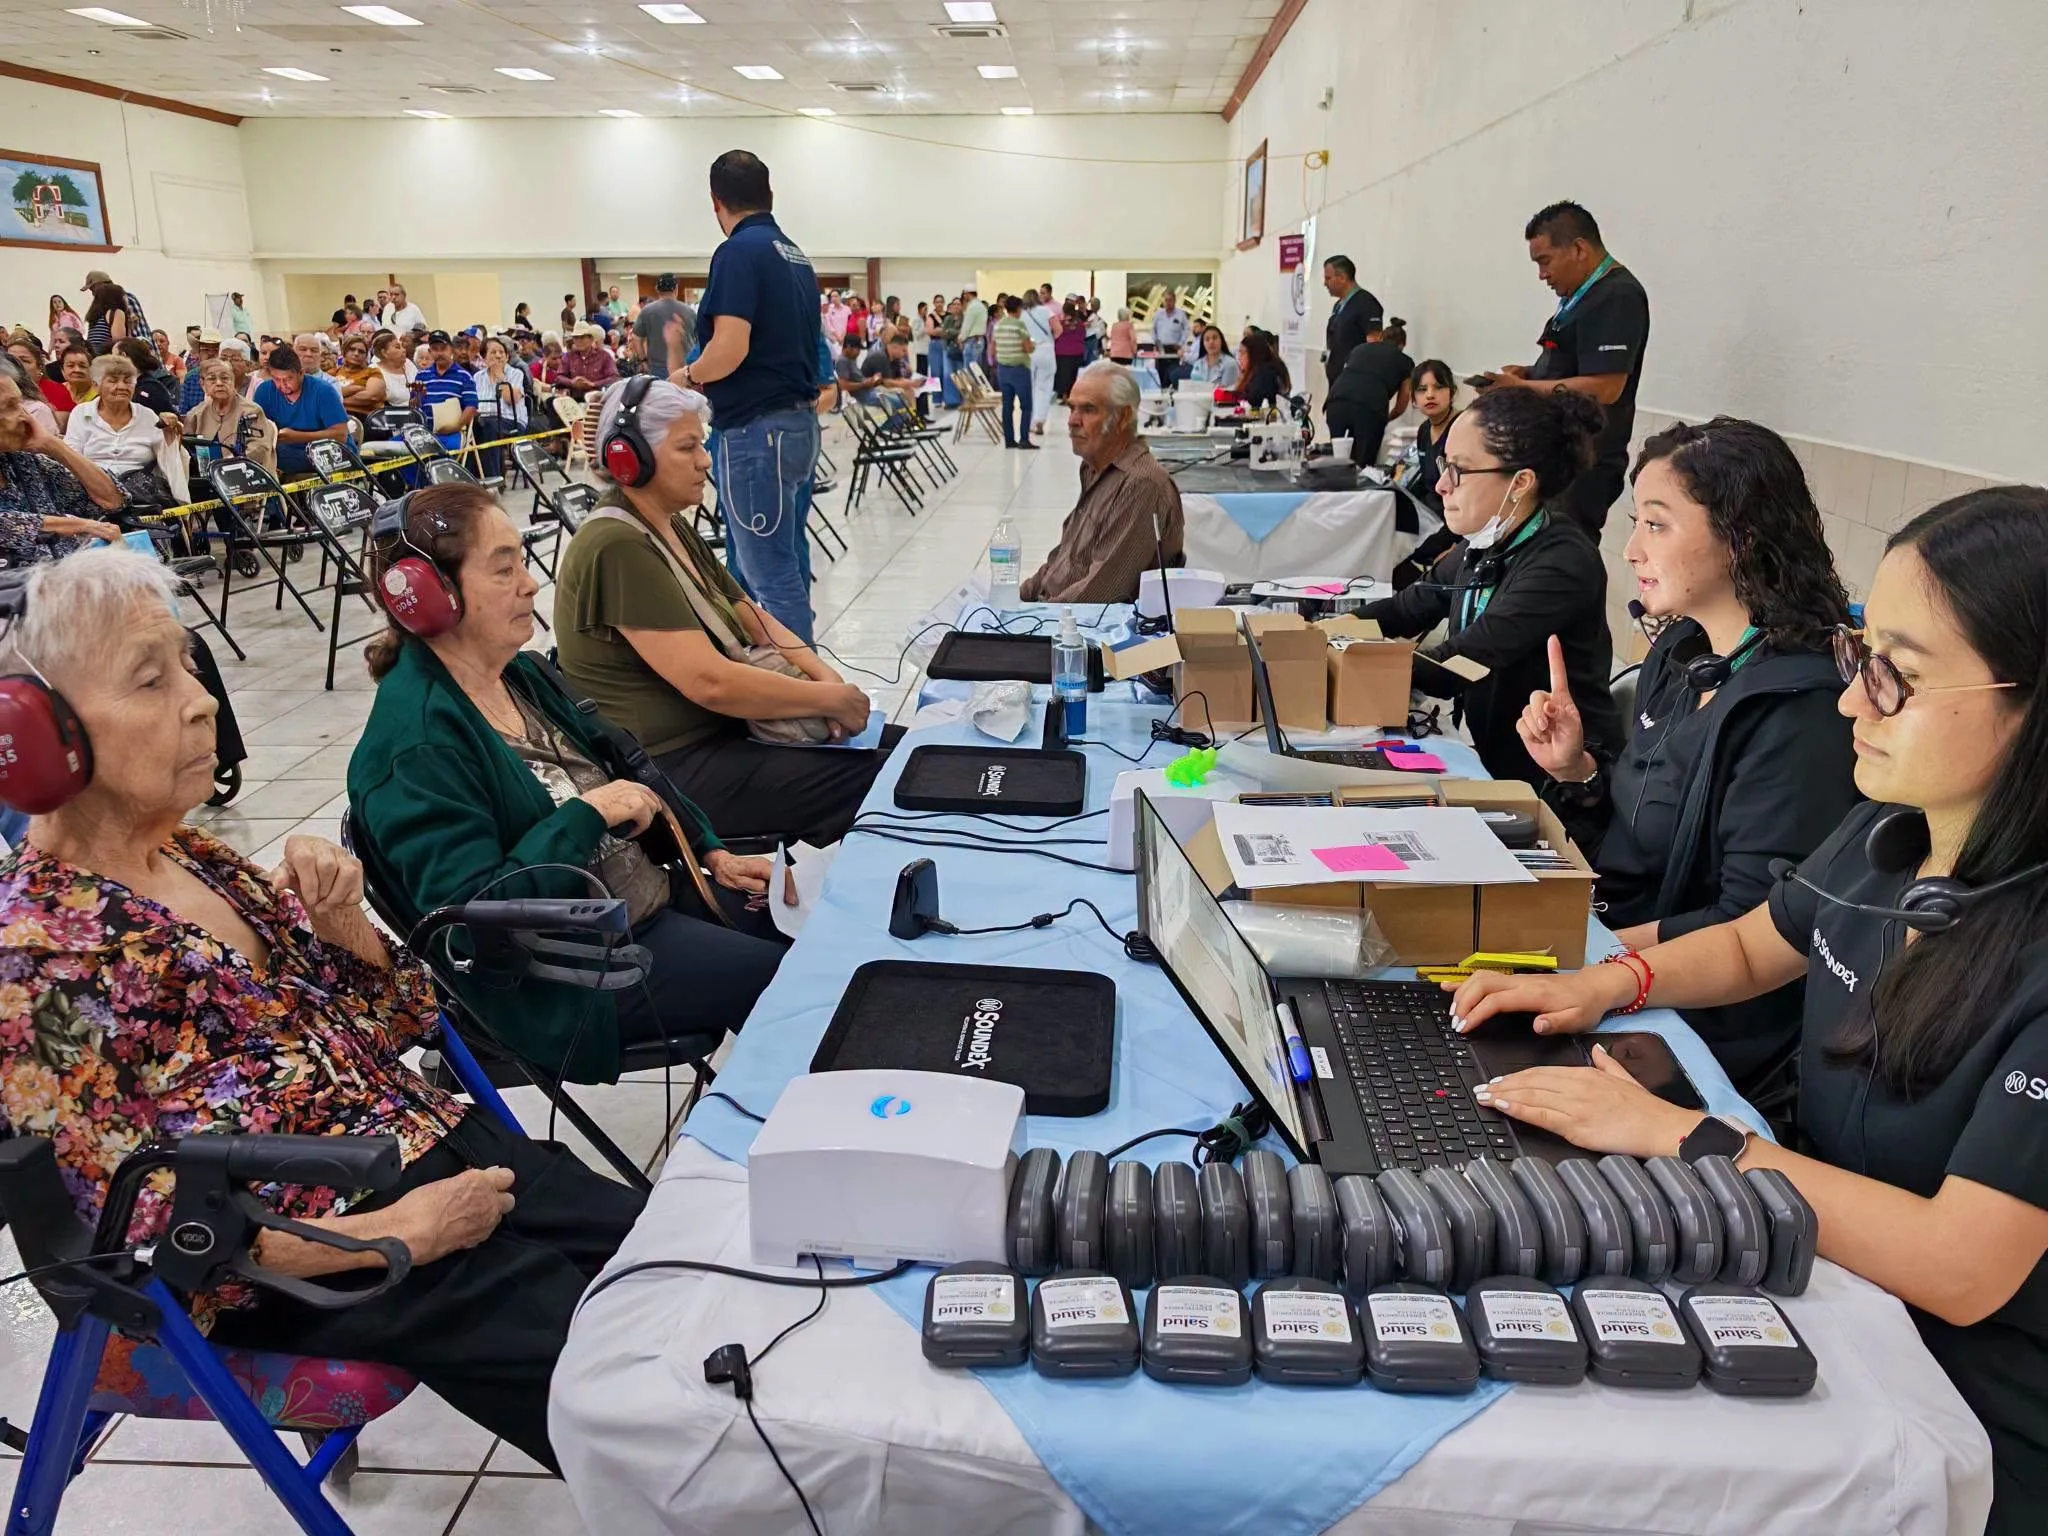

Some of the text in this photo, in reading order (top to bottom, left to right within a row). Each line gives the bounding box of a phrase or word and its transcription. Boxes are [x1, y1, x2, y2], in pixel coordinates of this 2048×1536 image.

[961, 1011, 1000, 1069] SOUNDEX
[939, 1305, 984, 1316] Salud
[1051, 1309, 1096, 1322] Salud
[1163, 1317, 1208, 1328] Salud
[1496, 1322, 1543, 1333] Salud
[1273, 1323, 1319, 1334] Salud
[1380, 1325, 1428, 1336] Salud
[1602, 1324, 1650, 1335] Salud
[1714, 1329, 1763, 1341] Salud
